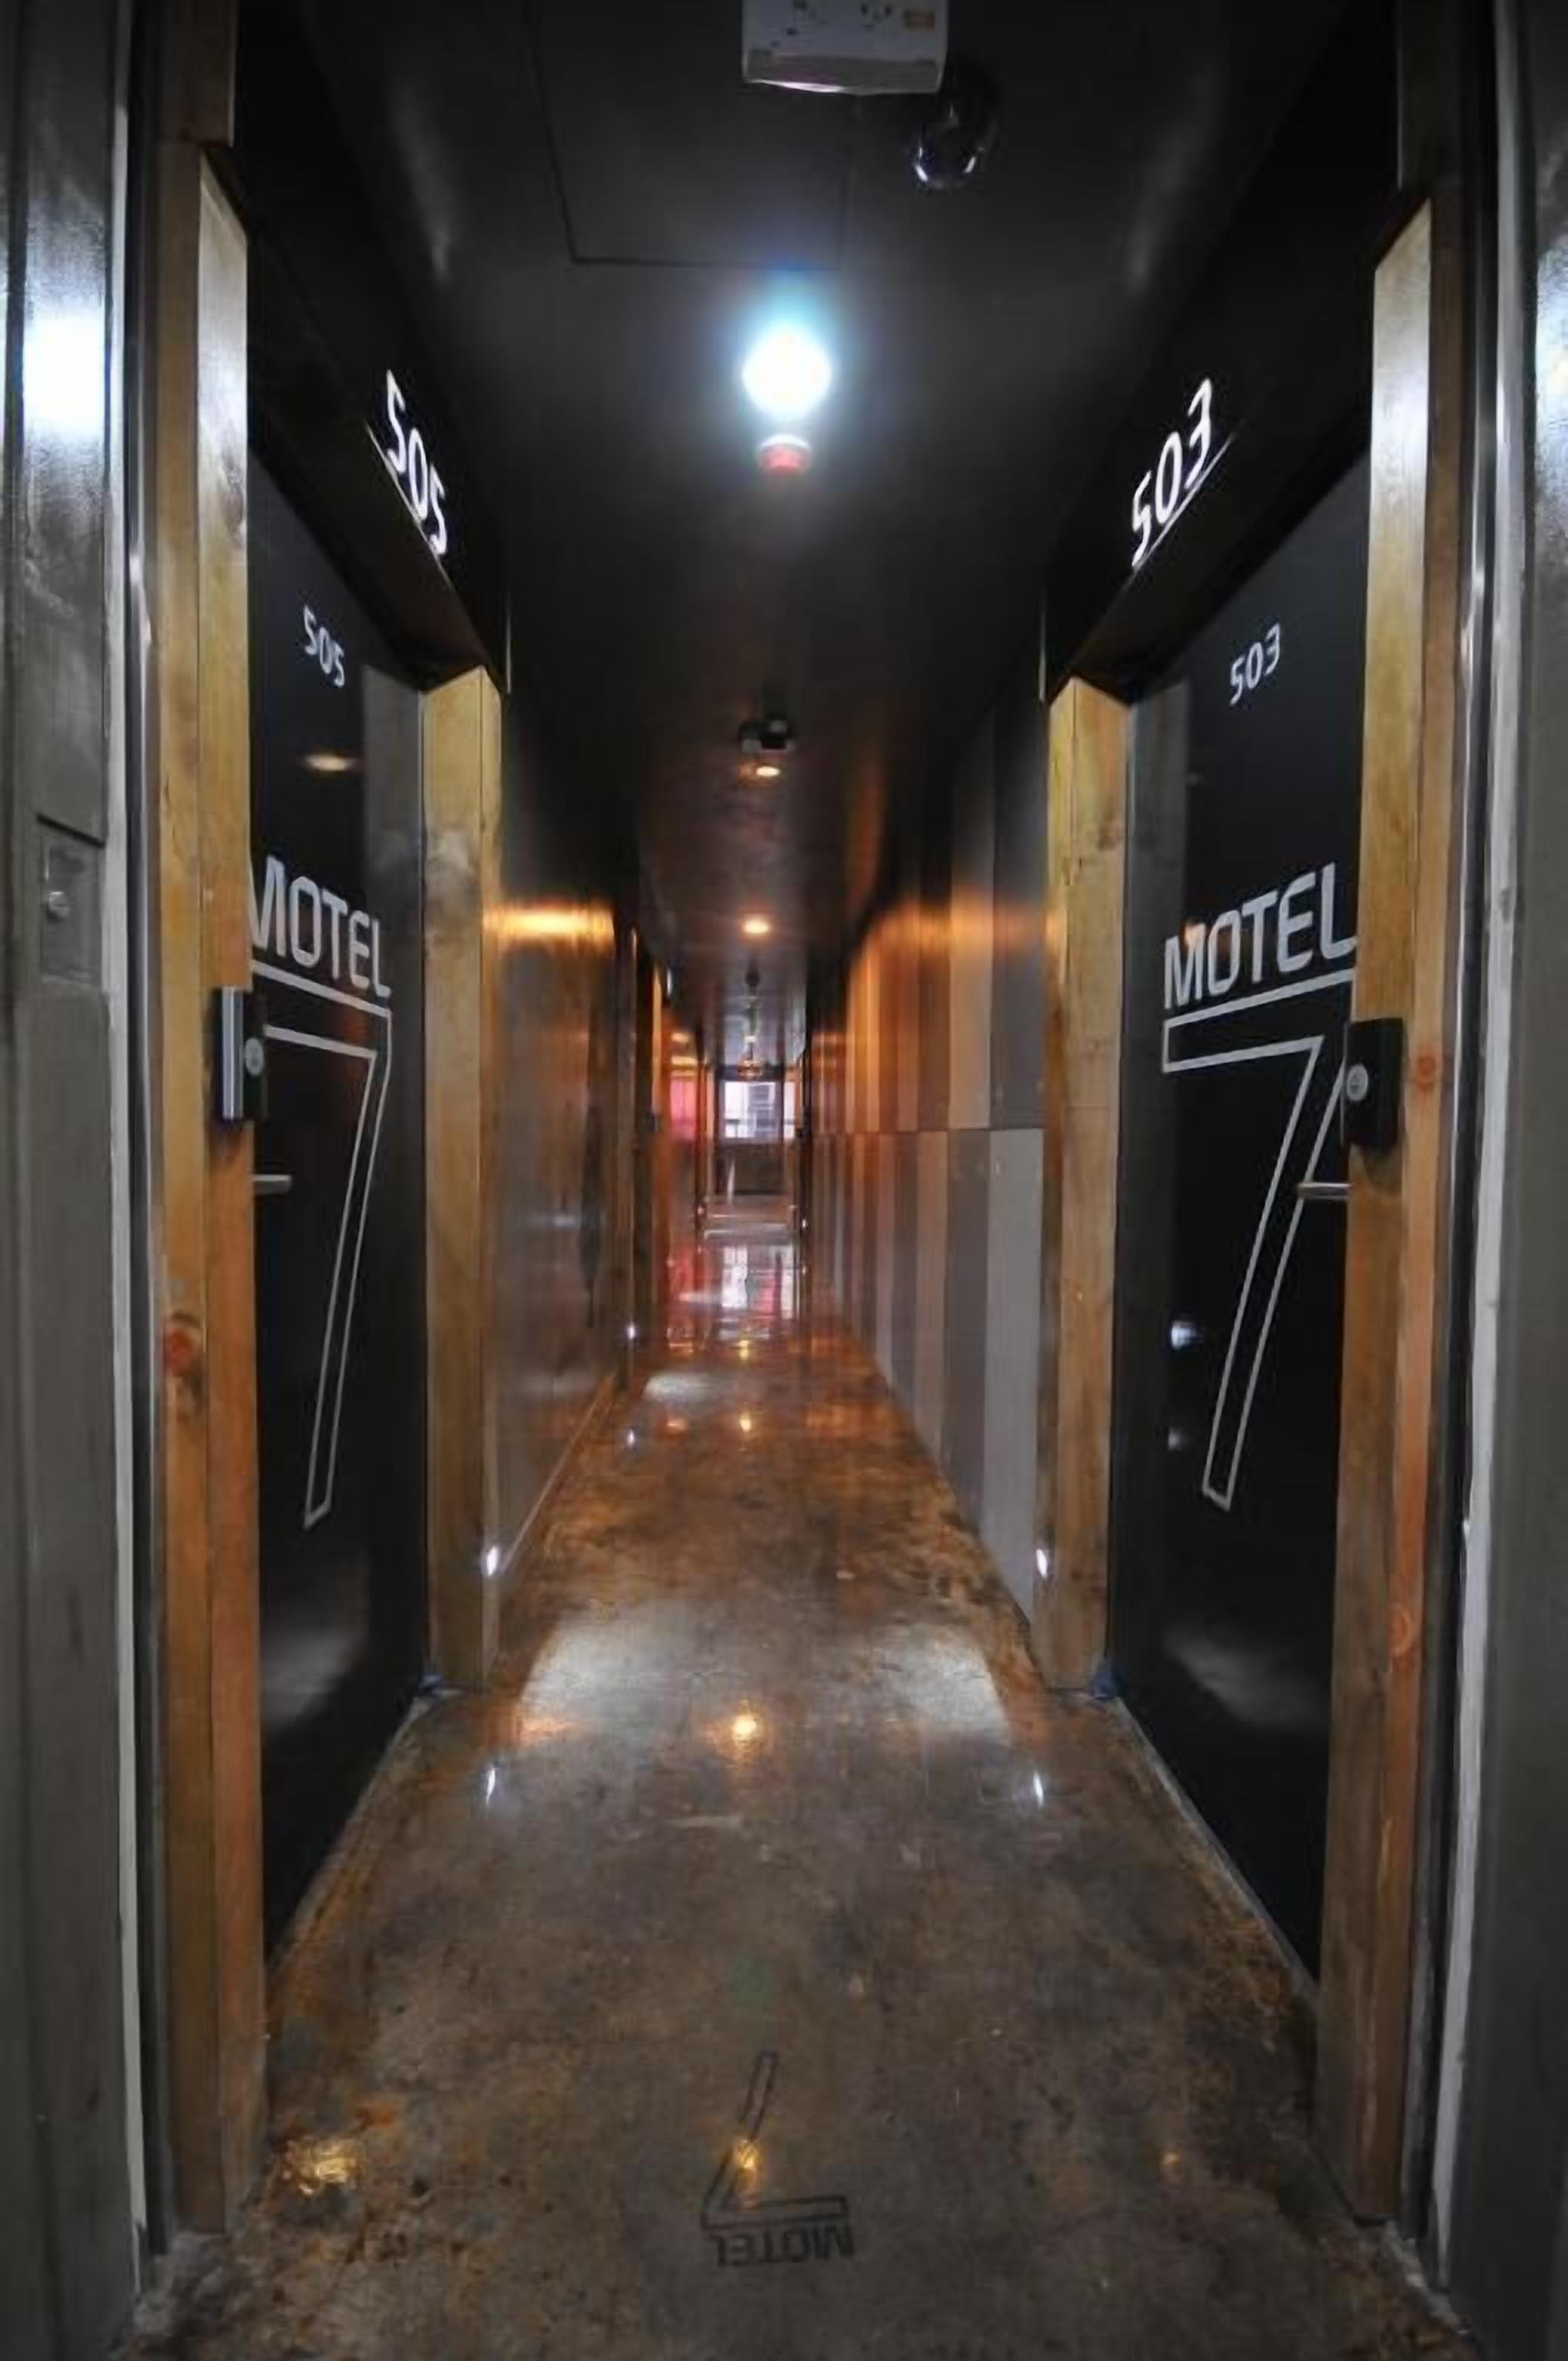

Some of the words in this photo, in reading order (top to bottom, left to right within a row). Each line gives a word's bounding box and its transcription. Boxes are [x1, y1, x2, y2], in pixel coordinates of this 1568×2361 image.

[386, 369, 447, 556] 505
[1131, 377, 1212, 567] 503
[304, 605, 345, 687] 505
[1230, 623, 1281, 706] 503
[250, 854, 392, 998] MOTEL
[1164, 862, 1357, 1010] MOTEL
[709, 2225, 855, 2268] MOTEL
